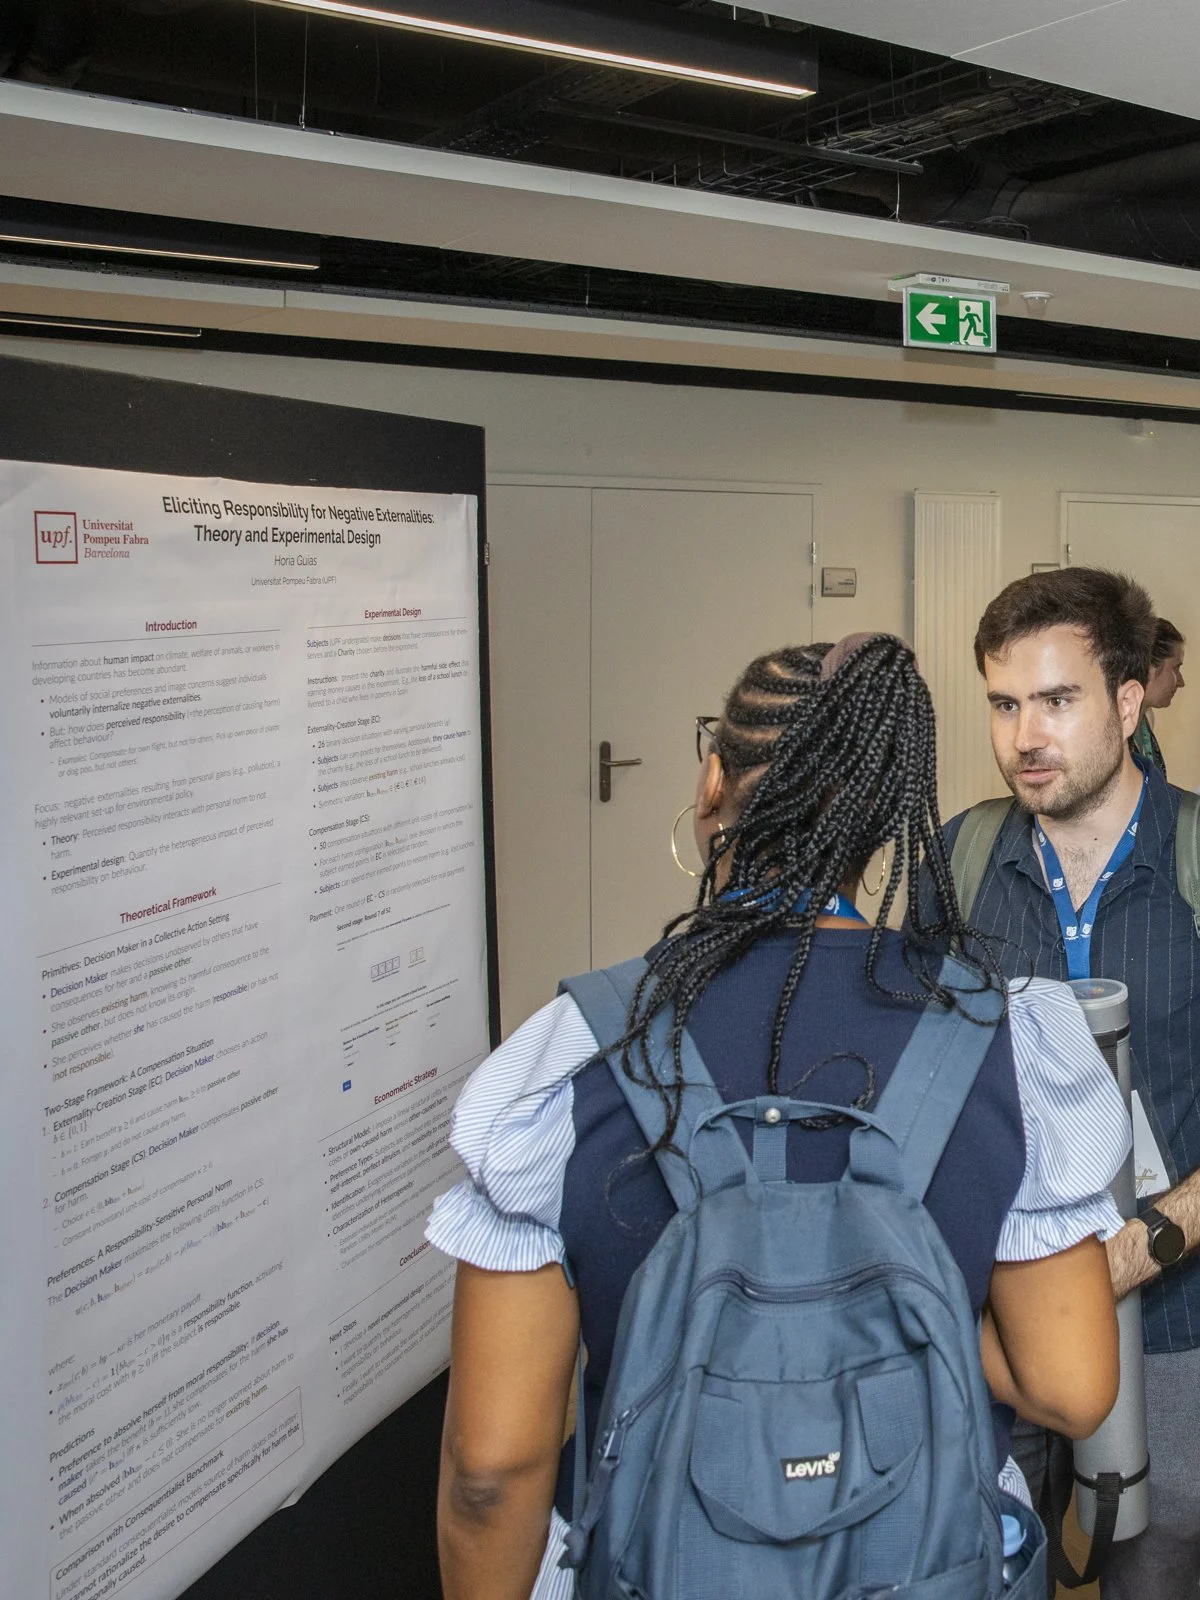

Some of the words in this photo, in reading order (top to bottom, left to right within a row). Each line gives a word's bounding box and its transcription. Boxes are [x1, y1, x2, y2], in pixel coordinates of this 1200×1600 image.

[162, 496, 221, 519] Eliciting
[223, 500, 310, 523] Responsibility
[311, 504, 327, 519] for
[329, 506, 374, 525] Negative
[376, 508, 435, 525] Externalities:
[82, 520, 133, 531] Universitat
[41, 526, 72, 548] upf.
[83, 534, 121, 546] Pompeu
[123, 535, 149, 545] Fabra
[194, 525, 242, 547] Theory
[245, 526, 268, 543] and
[272, 528, 345, 547] Experimental
[348, 530, 382, 548] Design
[84, 548, 130, 558] Barcelona
[274, 555, 295, 566] Horia
[297, 555, 317, 566] Guias
[251, 577, 281, 586] Universitat
[282, 577, 305, 586] Pompeu
[306, 577, 322, 585] Fabra
[365, 608, 401, 620] Experimental
[403, 608, 421, 618] Design
[145, 620, 197, 632] Introduction
[307, 639, 329, 649] Subjects
[32, 657, 78, 671] Information
[80, 657, 101, 667] about
[103, 654, 129, 665] human
[131, 653, 155, 665] impact
[32, 671, 76, 687] developing
[77, 668, 111, 682] countries
[113, 669, 126, 679] has
[128, 666, 154, 678] become
[370, 670, 385, 679] charity
[49, 694, 78, 705] Models
[112, 684, 153, 699] preferences
[49, 706, 91, 719] voluntarily
[92, 701, 130, 714] internalize
[132, 698, 161, 711] negative
[162, 693, 202, 706] externalities.
[106, 716, 140, 730] perceived
[142, 710, 186, 725] responsibility
[308, 719, 356, 734] Externality-Creation
[358, 717, 370, 727] Stage
[49, 735, 71, 750] affect
[73, 731, 114, 746] behaviour?
[317, 755, 339, 765] Subjects
[318, 782, 338, 792] Subjects
[308, 822, 345, 837] Compensation
[346, 817, 359, 828] Stage
[51, 860, 100, 881] Experimental
[319, 882, 340, 894] Subjects
[120, 899, 171, 924] Theoretical
[172, 886, 217, 909] Framework
[310, 909, 333, 922] Payment:
[41, 961, 82, 981] Primitives:
[84, 949, 116, 968] Decision
[117, 941, 139, 955] Maker
[154, 926, 186, 944] Collective
[187, 919, 207, 933] Action
[208, 912, 230, 928] Setting
[50, 978, 83, 999] Decision
[85, 971, 108, 985] Maker
[101, 999, 129, 1015] existing
[51, 1030, 79, 1048] passive
[45, 1093, 85, 1118] Two-Stage
[87, 1075, 129, 1098] Framework:
[137, 1050, 185, 1078] Compensation
[186, 1038, 215, 1056] Situation
[374, 1080, 413, 1105] Econometric
[414, 1066, 438, 1085] Strategy
[53, 1093, 127, 1132] Externality-Creation
[128, 1083, 148, 1097] Stage
[166, 1064, 193, 1082] Decision
[195, 1054, 215, 1068] Maker
[328, 1138, 353, 1155] Structural
[54, 1167, 109, 1203] Compensation
[110, 1158, 130, 1175] Stage
[149, 1135, 178, 1156] Decision
[179, 1125, 200, 1140] Maker
[330, 1162, 357, 1182] Preference
[333, 1203, 374, 1235] Characterization
[47, 1255, 95, 1287] Preferences:
[105, 1203, 186, 1255] Responsibility-Sensitive
[187, 1188, 214, 1209] Personal
[215, 1178, 233, 1194] Norm
[64, 1272, 98, 1298] Decision
[99, 1259, 123, 1279] Maker
[50, 1428, 95, 1463] Predictions
[59, 1445, 102, 1477] Preference
[113, 1417, 141, 1440] absolve
[59, 1503, 85, 1525] When
[86, 1477, 121, 1507] absolved
[55, 1538, 105, 1581] Comparison
[125, 1479, 185, 1529] Consequentialist
[186, 1450, 225, 1482] Benchmark
